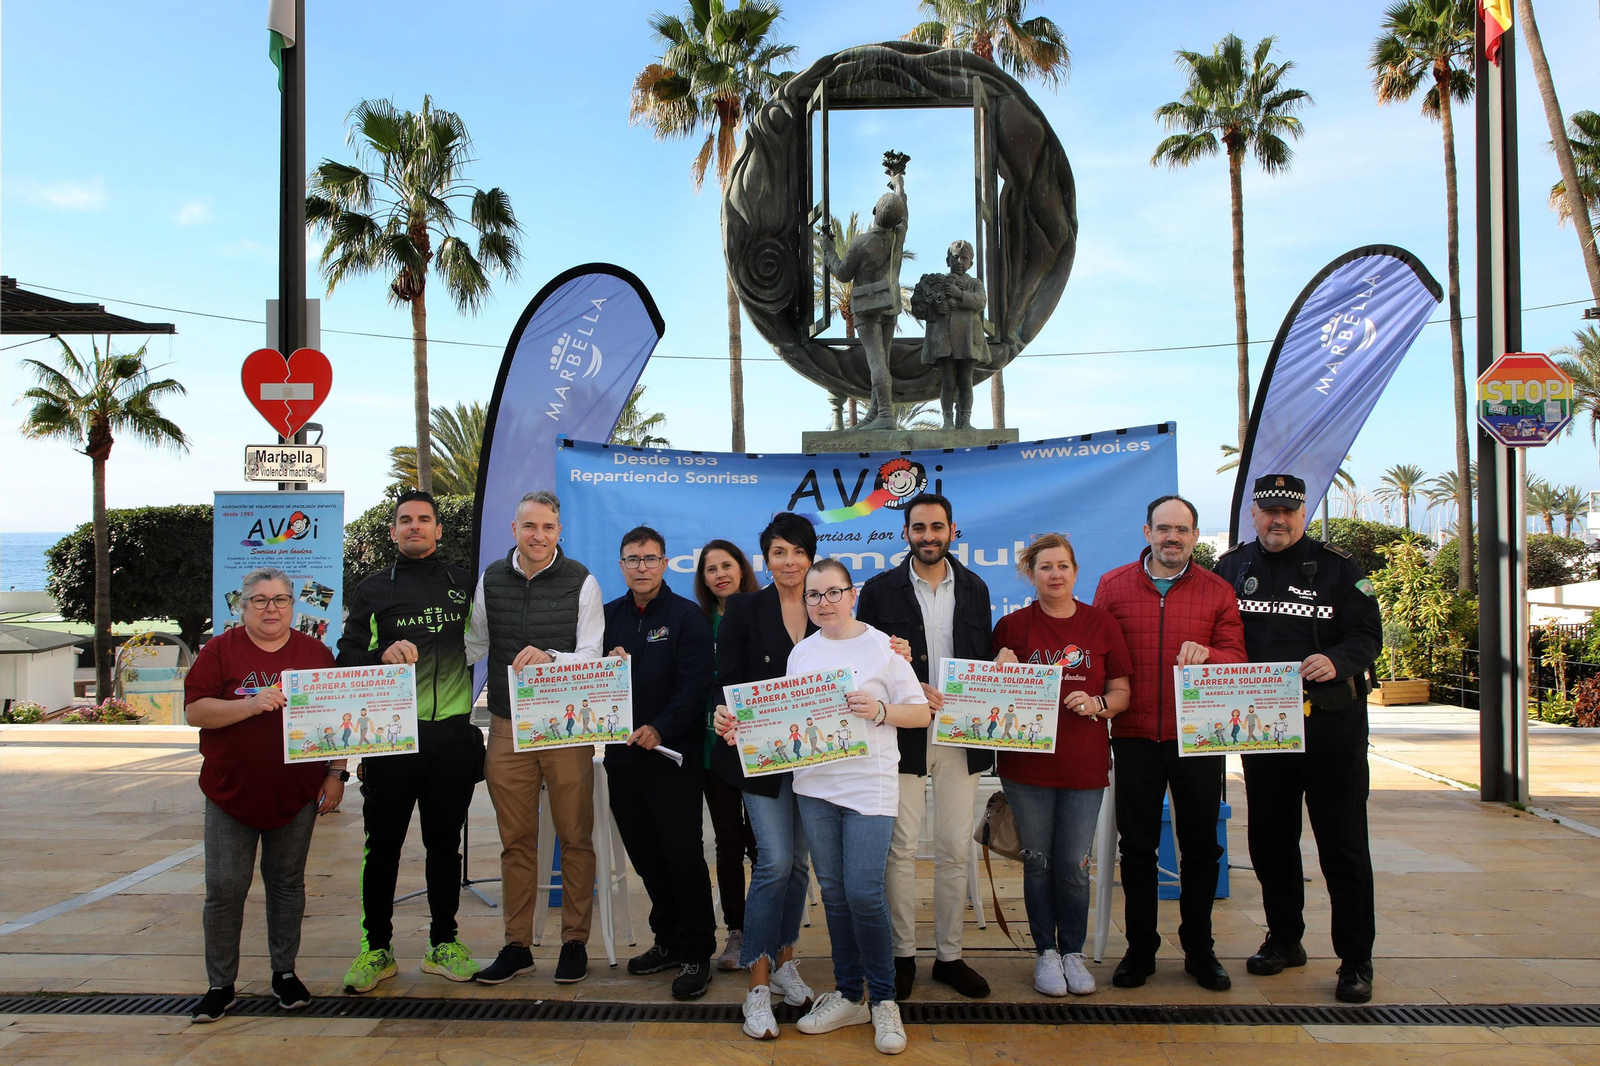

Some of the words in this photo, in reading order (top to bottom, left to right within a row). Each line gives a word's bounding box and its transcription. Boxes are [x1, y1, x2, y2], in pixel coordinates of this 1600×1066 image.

[1315, 275, 1380, 395] MARBELLA
[545, 298, 607, 420] MARBELLA
[1486, 380, 1564, 404] STOP
[1020, 438, 1151, 460] www.avoi.es
[256, 450, 312, 463] Marbella
[614, 452, 672, 466] Desde
[675, 456, 718, 466] 1993
[261, 466, 287, 477] violencia
[289, 467, 316, 477] machista
[570, 469, 679, 484] Repartiendo
[685, 471, 758, 484] Sonrisas
[867, 530, 894, 544] por
[397, 613, 461, 627] MARBELLA
[327, 668, 384, 679] CAMINATA
[549, 662, 603, 674] CAMINATA
[982, 665, 1034, 675] CAMINATA
[1216, 666, 1271, 675] CAMINATA
[528, 676, 568, 684] CARRERA
[572, 671, 614, 680] SOLIDARIA
[766, 674, 823, 692] CAMINATA
[958, 674, 999, 682] CARRERA
[1002, 677, 1044, 685] SOLIDARIA
[303, 682, 346, 691] CARRERA
[350, 679, 396, 688] SOLIDARIA
[745, 693, 787, 706] CARRERA
[791, 683, 837, 698] SOLIDARIA
[759, 706, 788, 715] MARBELLA
